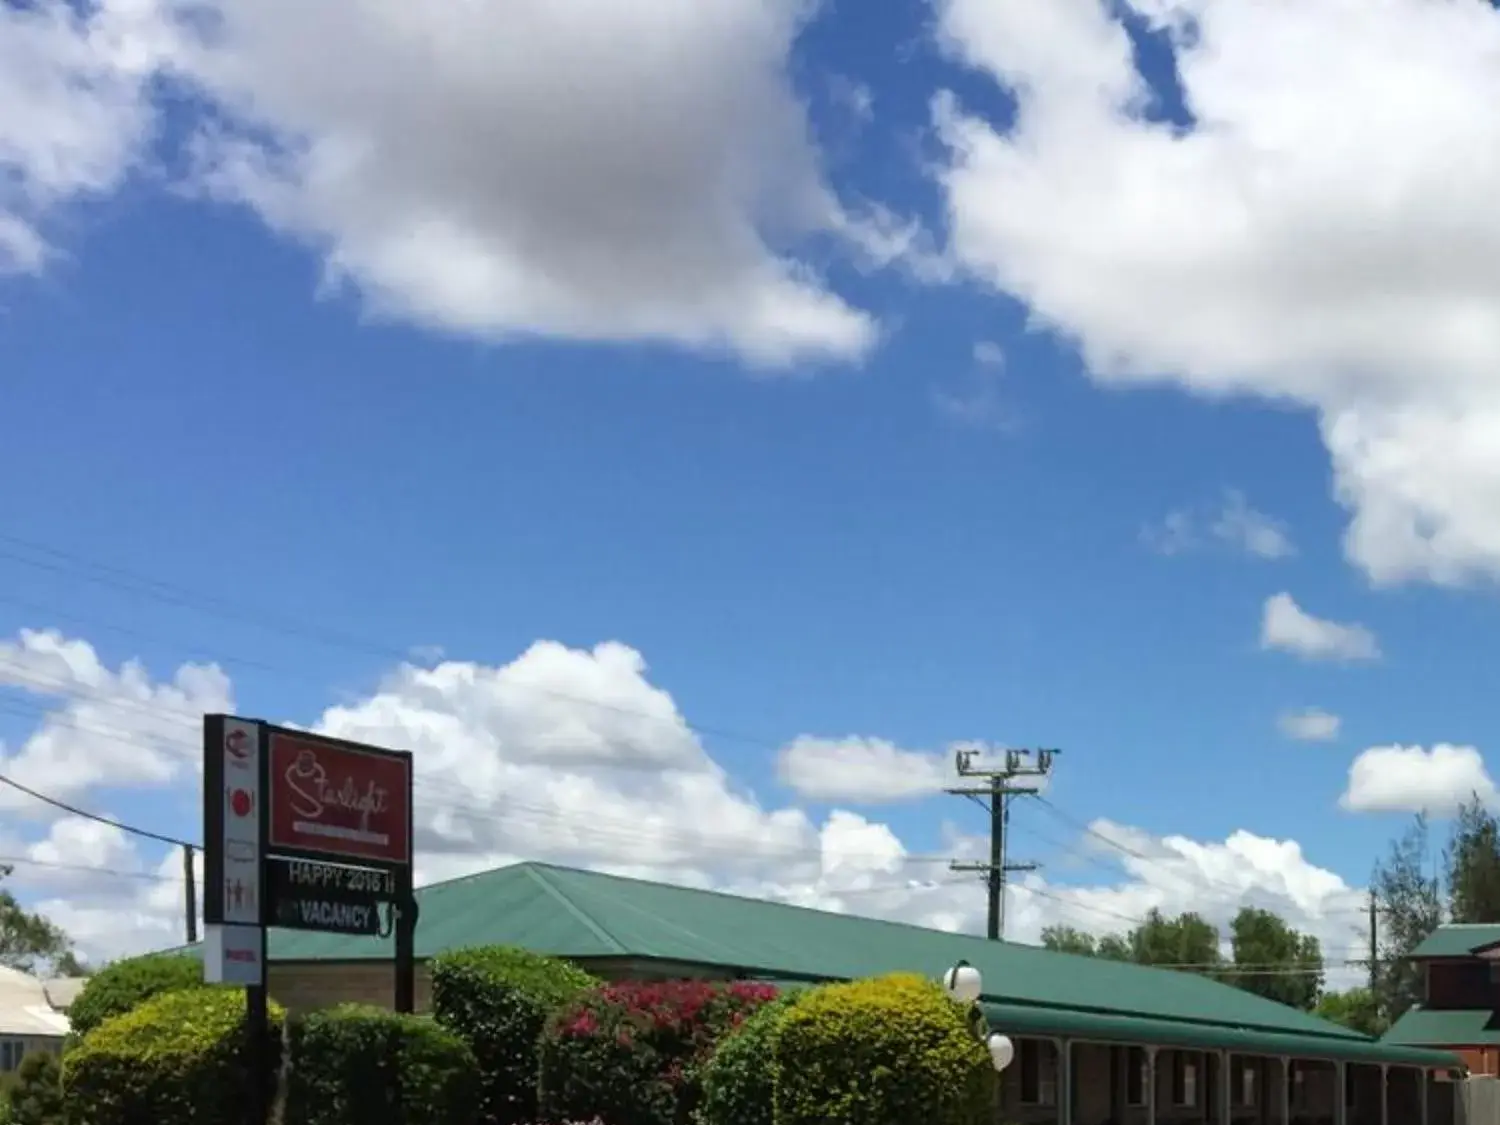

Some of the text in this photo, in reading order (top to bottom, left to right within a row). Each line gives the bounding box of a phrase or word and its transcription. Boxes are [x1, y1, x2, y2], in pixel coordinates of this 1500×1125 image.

[285, 750, 388, 831] Starlight
[289, 861, 343, 887] HAPPY
[347, 870, 382, 892] 2016
[300, 900, 371, 928] VACANCY
